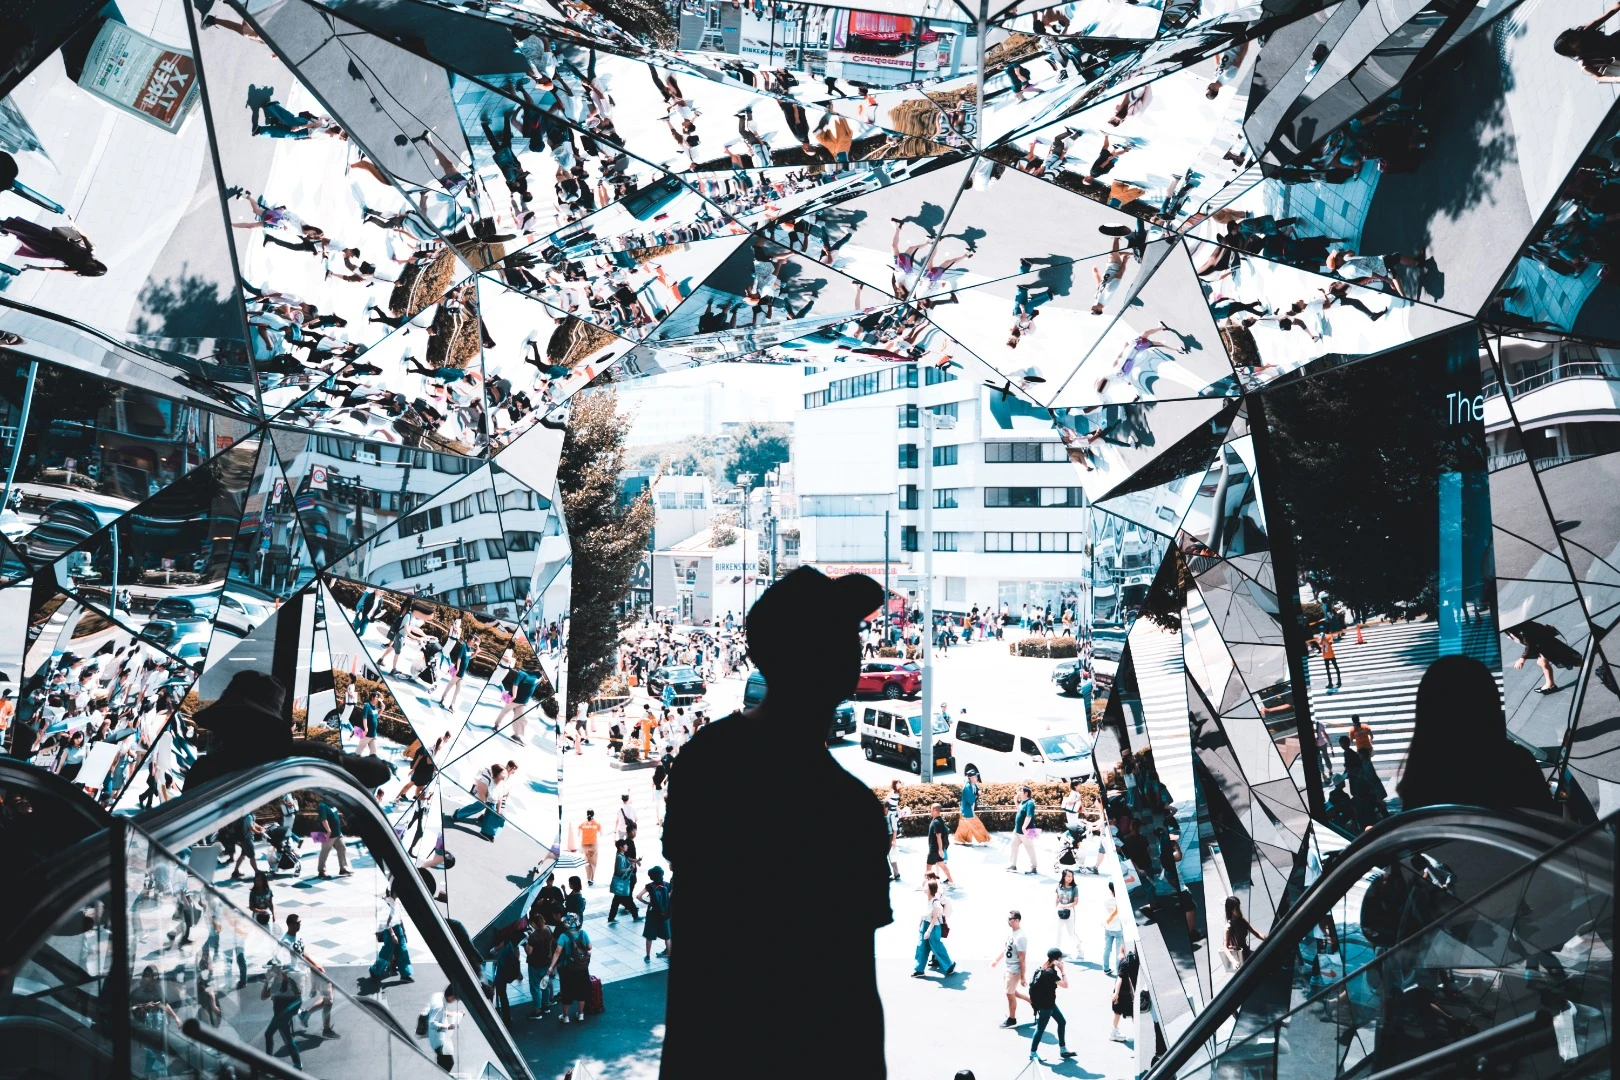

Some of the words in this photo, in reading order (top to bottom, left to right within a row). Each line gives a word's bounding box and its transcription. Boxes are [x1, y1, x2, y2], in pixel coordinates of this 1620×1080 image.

[1446, 391, 1484, 425] The
[715, 562, 757, 571] BIRKENSTOCK
[825, 565, 898, 575] Condomana
[875, 739, 896, 749] POLICE
